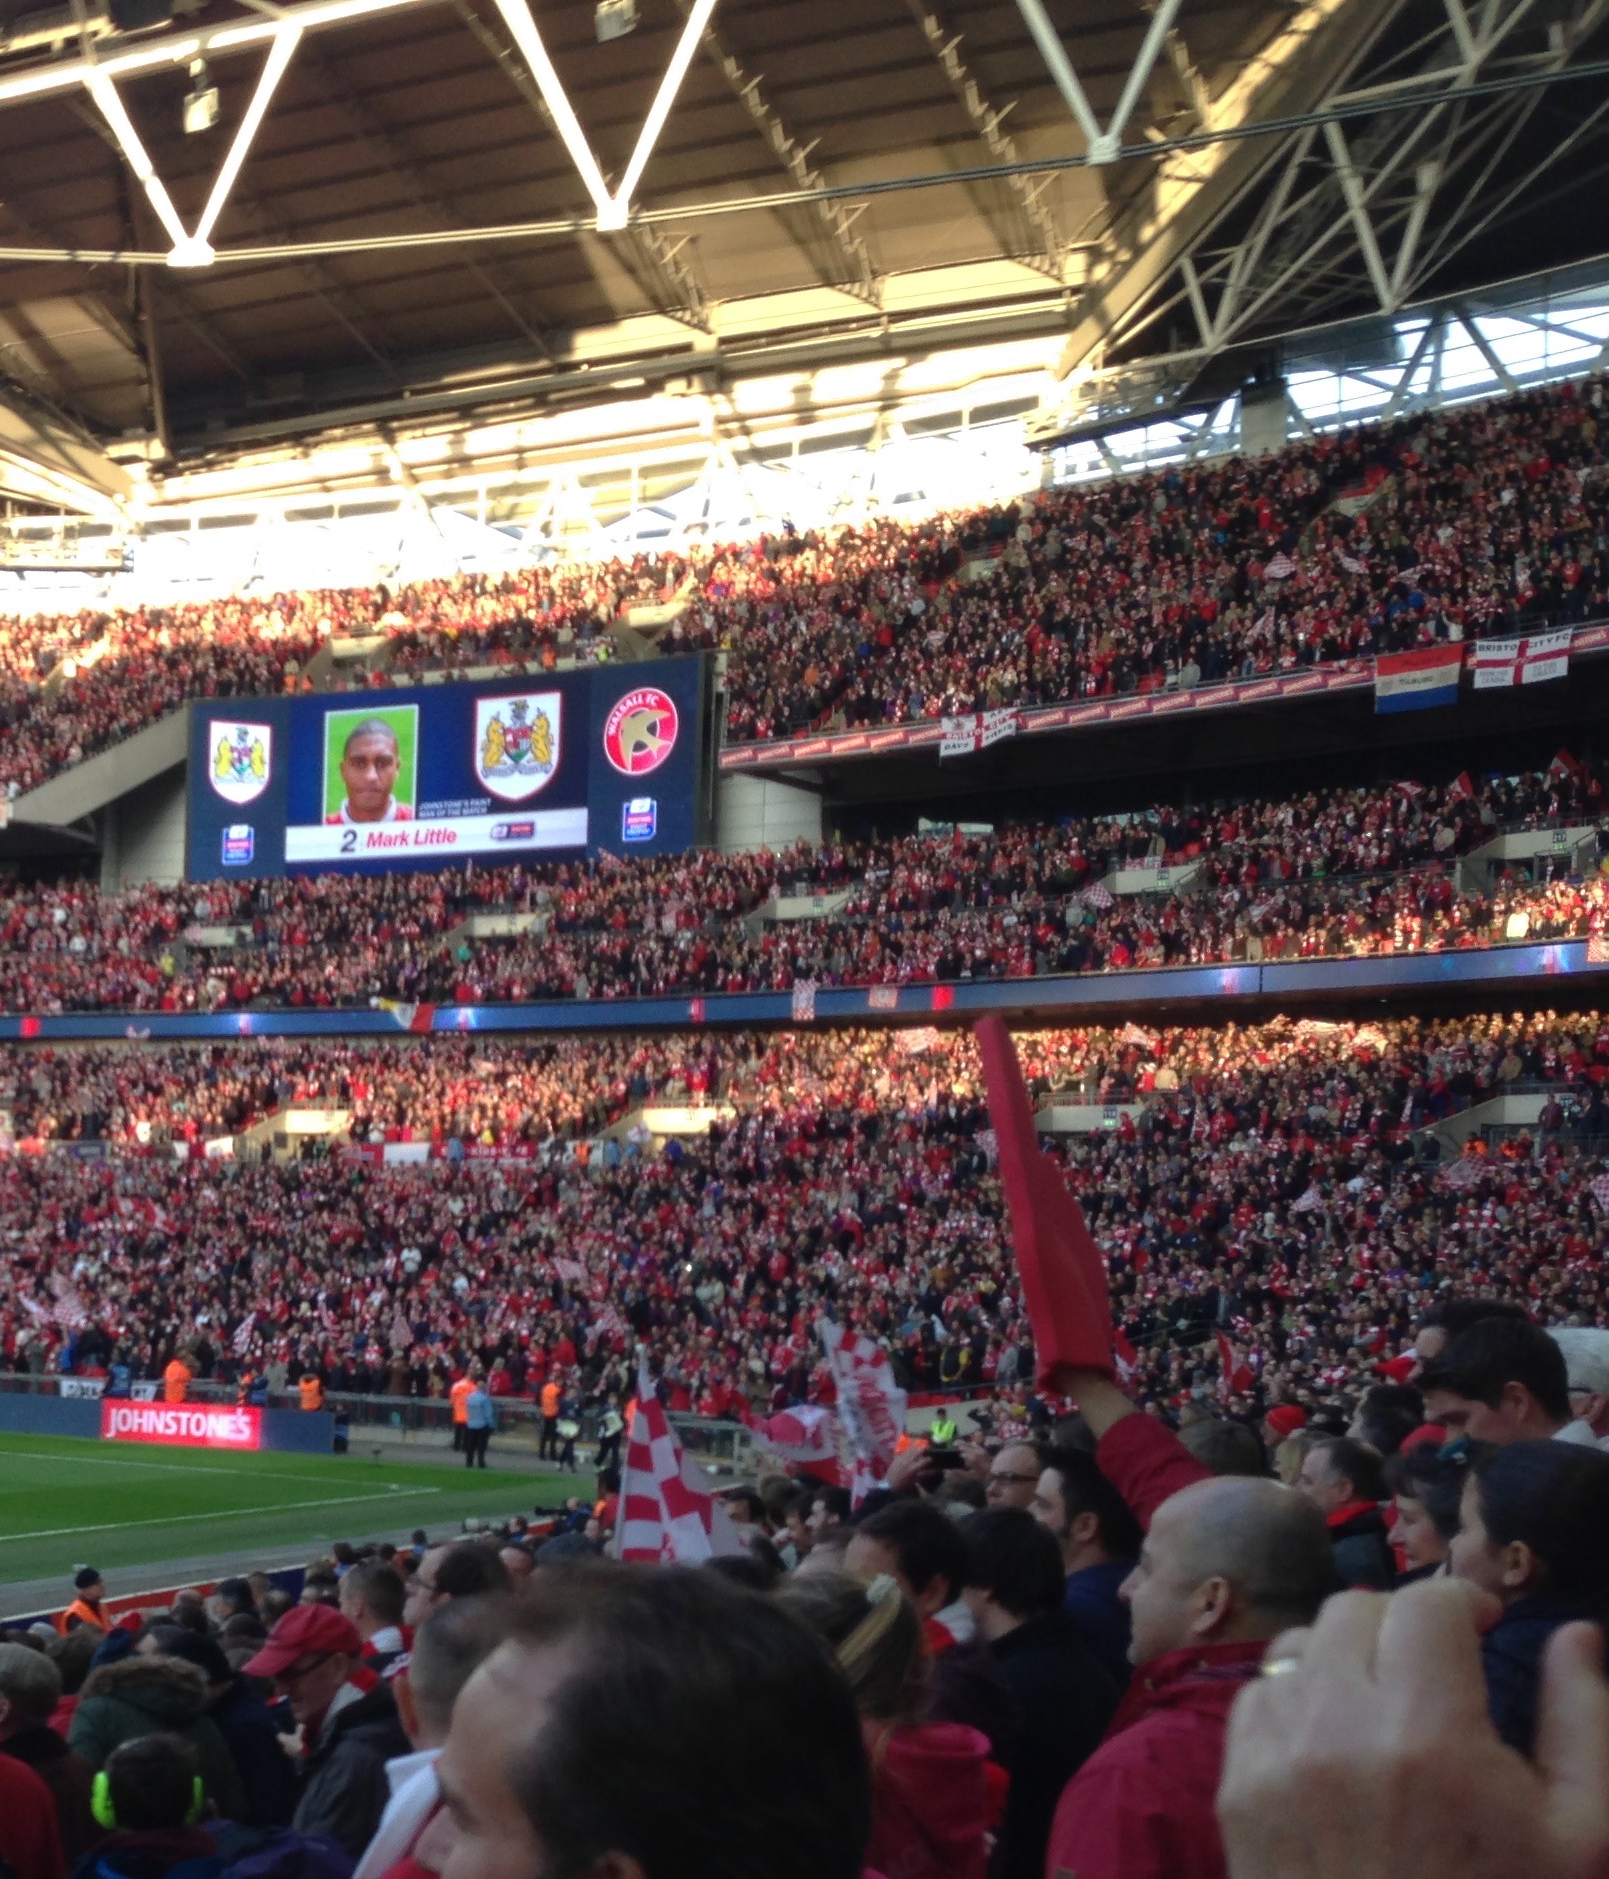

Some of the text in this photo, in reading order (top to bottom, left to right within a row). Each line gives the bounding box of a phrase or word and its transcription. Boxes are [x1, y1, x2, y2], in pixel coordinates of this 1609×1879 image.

[608, 693, 660, 736] WALSALL FC
[340, 827, 457, 853] 2 Mark Little
[105, 1406, 252, 1441] JOHNSTONE'S
